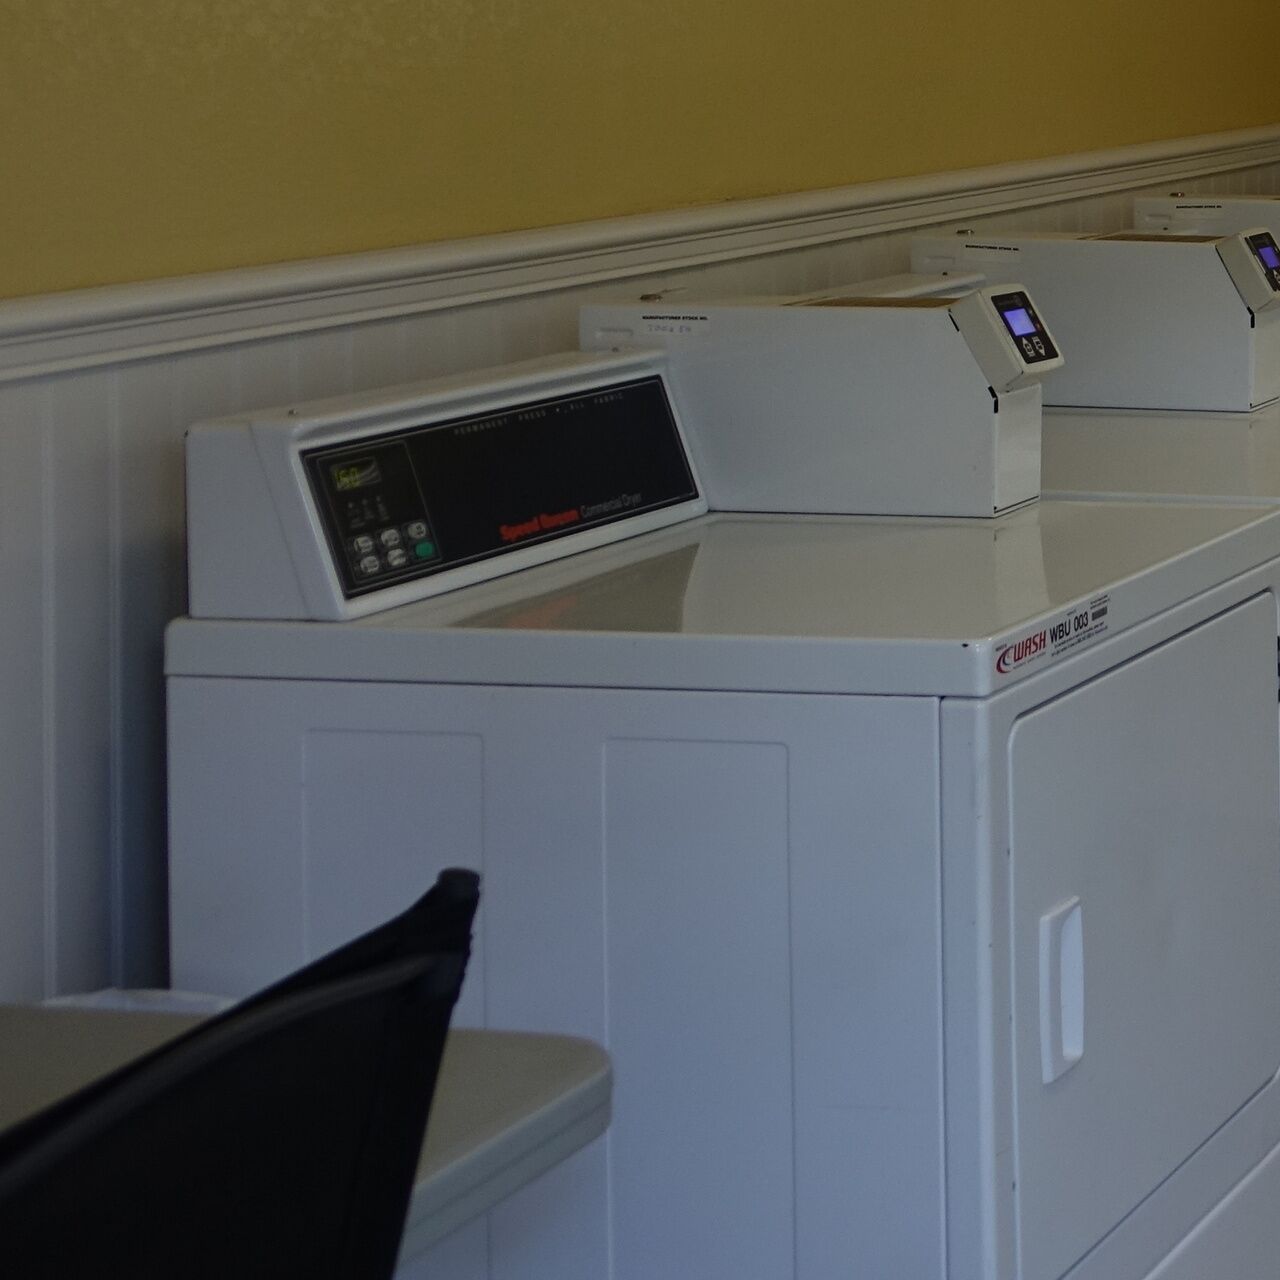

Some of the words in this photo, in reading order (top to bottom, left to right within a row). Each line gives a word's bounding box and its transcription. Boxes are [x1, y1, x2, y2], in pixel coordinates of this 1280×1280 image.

[454, 418, 508, 436] PERMANENT
[518, 409, 547, 422] PRESS
[593, 393, 624, 406] FABRIC
[500, 517, 540, 541] Speed
[540, 508, 580, 528] Queen
[581, 496, 623, 518] Commercial
[623, 492, 642, 509] Dryer
[1013, 629, 1047, 663] WASH
[1049, 620, 1071, 644] WBU
[1073, 611, 1089, 632] 003
